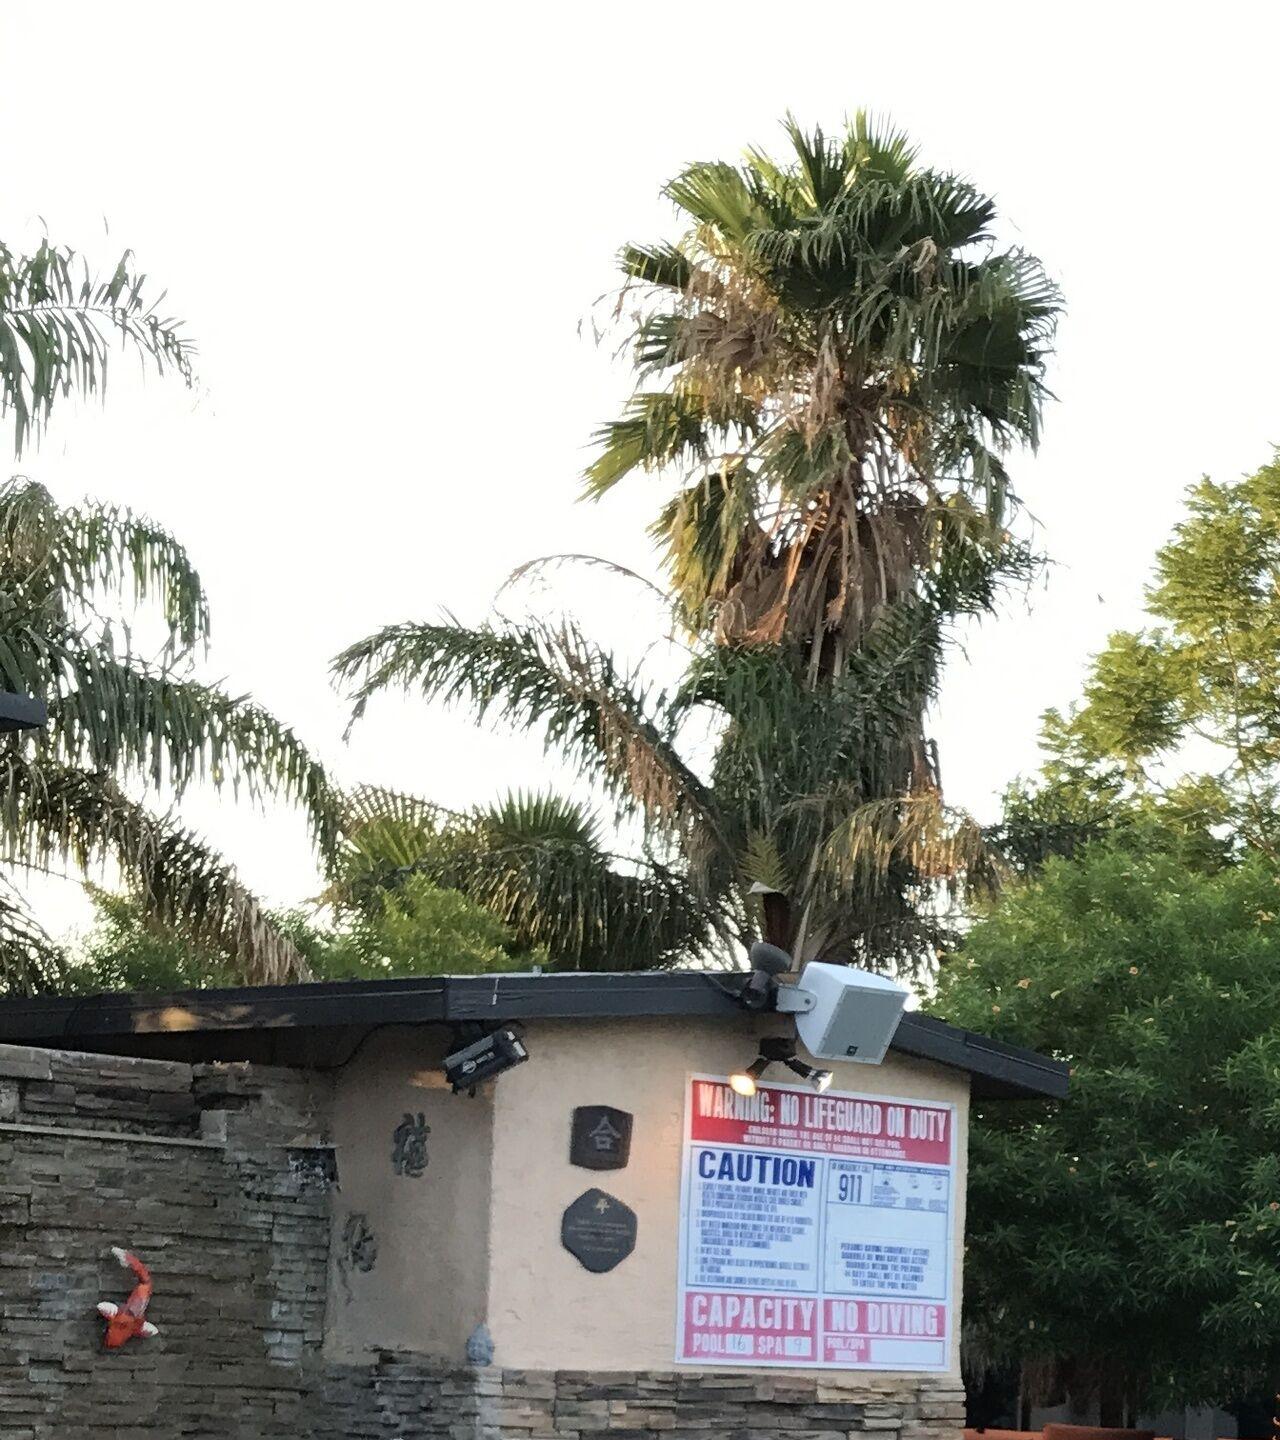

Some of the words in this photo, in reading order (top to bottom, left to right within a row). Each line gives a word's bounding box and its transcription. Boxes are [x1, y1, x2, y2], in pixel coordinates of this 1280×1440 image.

[698, 1083, 775, 1123] WARNING:
[780, 1093, 800, 1127] NO
[804, 1096, 882, 1136] LIFEGUARD
[886, 1106, 906, 1138] ON
[909, 1108, 947, 1142] DUTY
[698, 1150, 816, 1188] CAUTION
[838, 1173, 863, 1202] 911
[692, 1294, 815, 1331] CAPACITY
[831, 1301, 859, 1332] NO
[867, 1303, 938, 1335] DIVING
[692, 1333, 725, 1353] POOL
[758, 1336, 785, 1355] SPA
